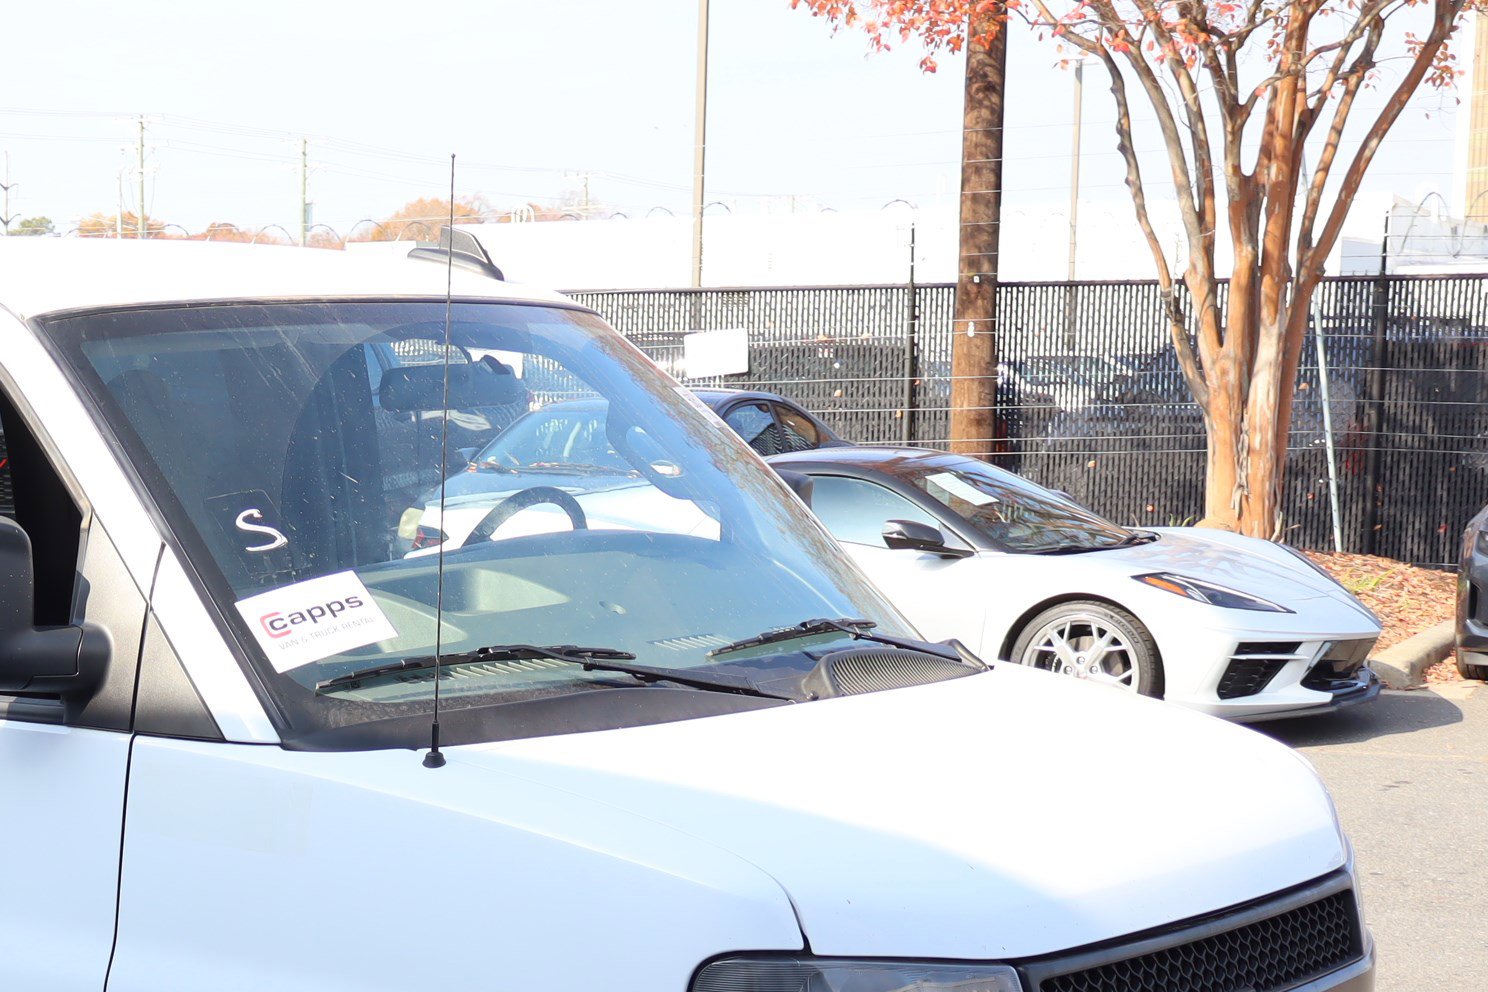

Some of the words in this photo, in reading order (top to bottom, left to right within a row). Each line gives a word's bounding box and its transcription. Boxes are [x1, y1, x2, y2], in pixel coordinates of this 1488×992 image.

[235, 508, 288, 552] S
[278, 638, 299, 650] VAN
[309, 626, 340, 641] TRUCK
[341, 616, 376, 631] RENTAL
